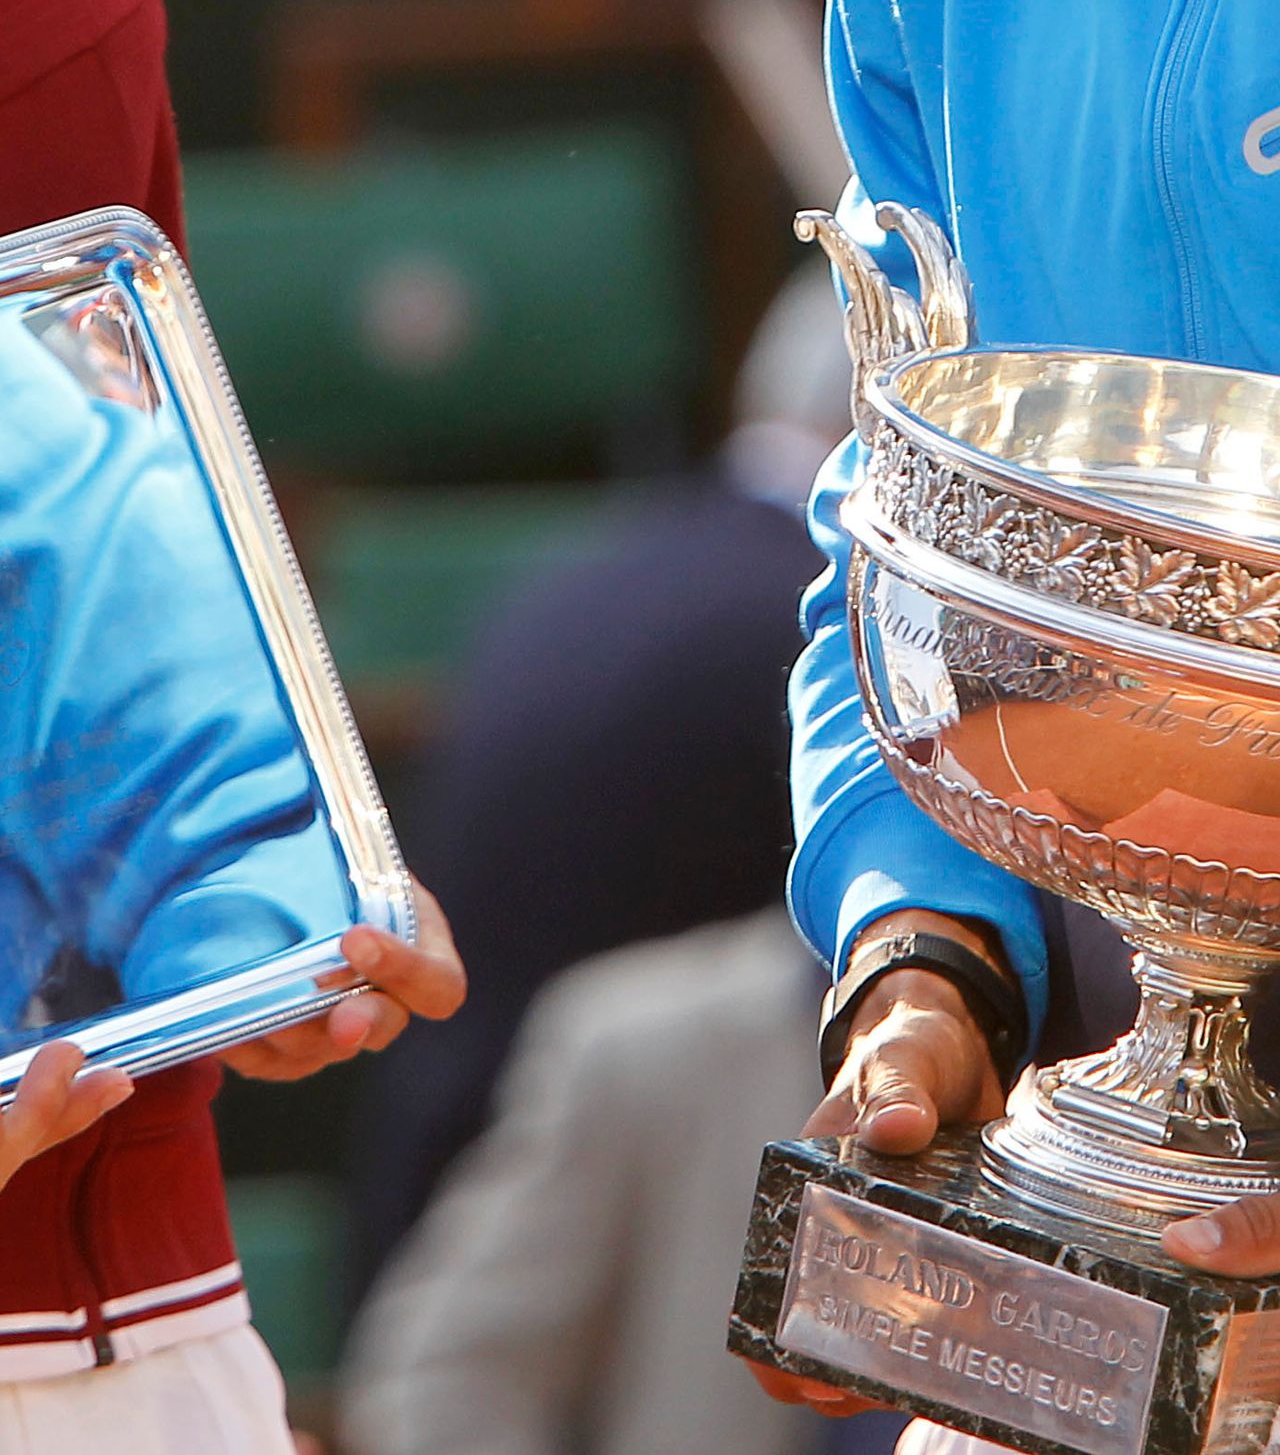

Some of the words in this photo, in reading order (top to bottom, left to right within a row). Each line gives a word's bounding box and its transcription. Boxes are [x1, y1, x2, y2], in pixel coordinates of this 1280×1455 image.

[1119, 690, 1183, 735] de
[815, 1228, 977, 1310] ROLAND
[990, 1290, 1148, 1374] GARROS
[818, 1294, 934, 1362] SIMPLE
[938, 1337, 1118, 1427] MESSIEURS
